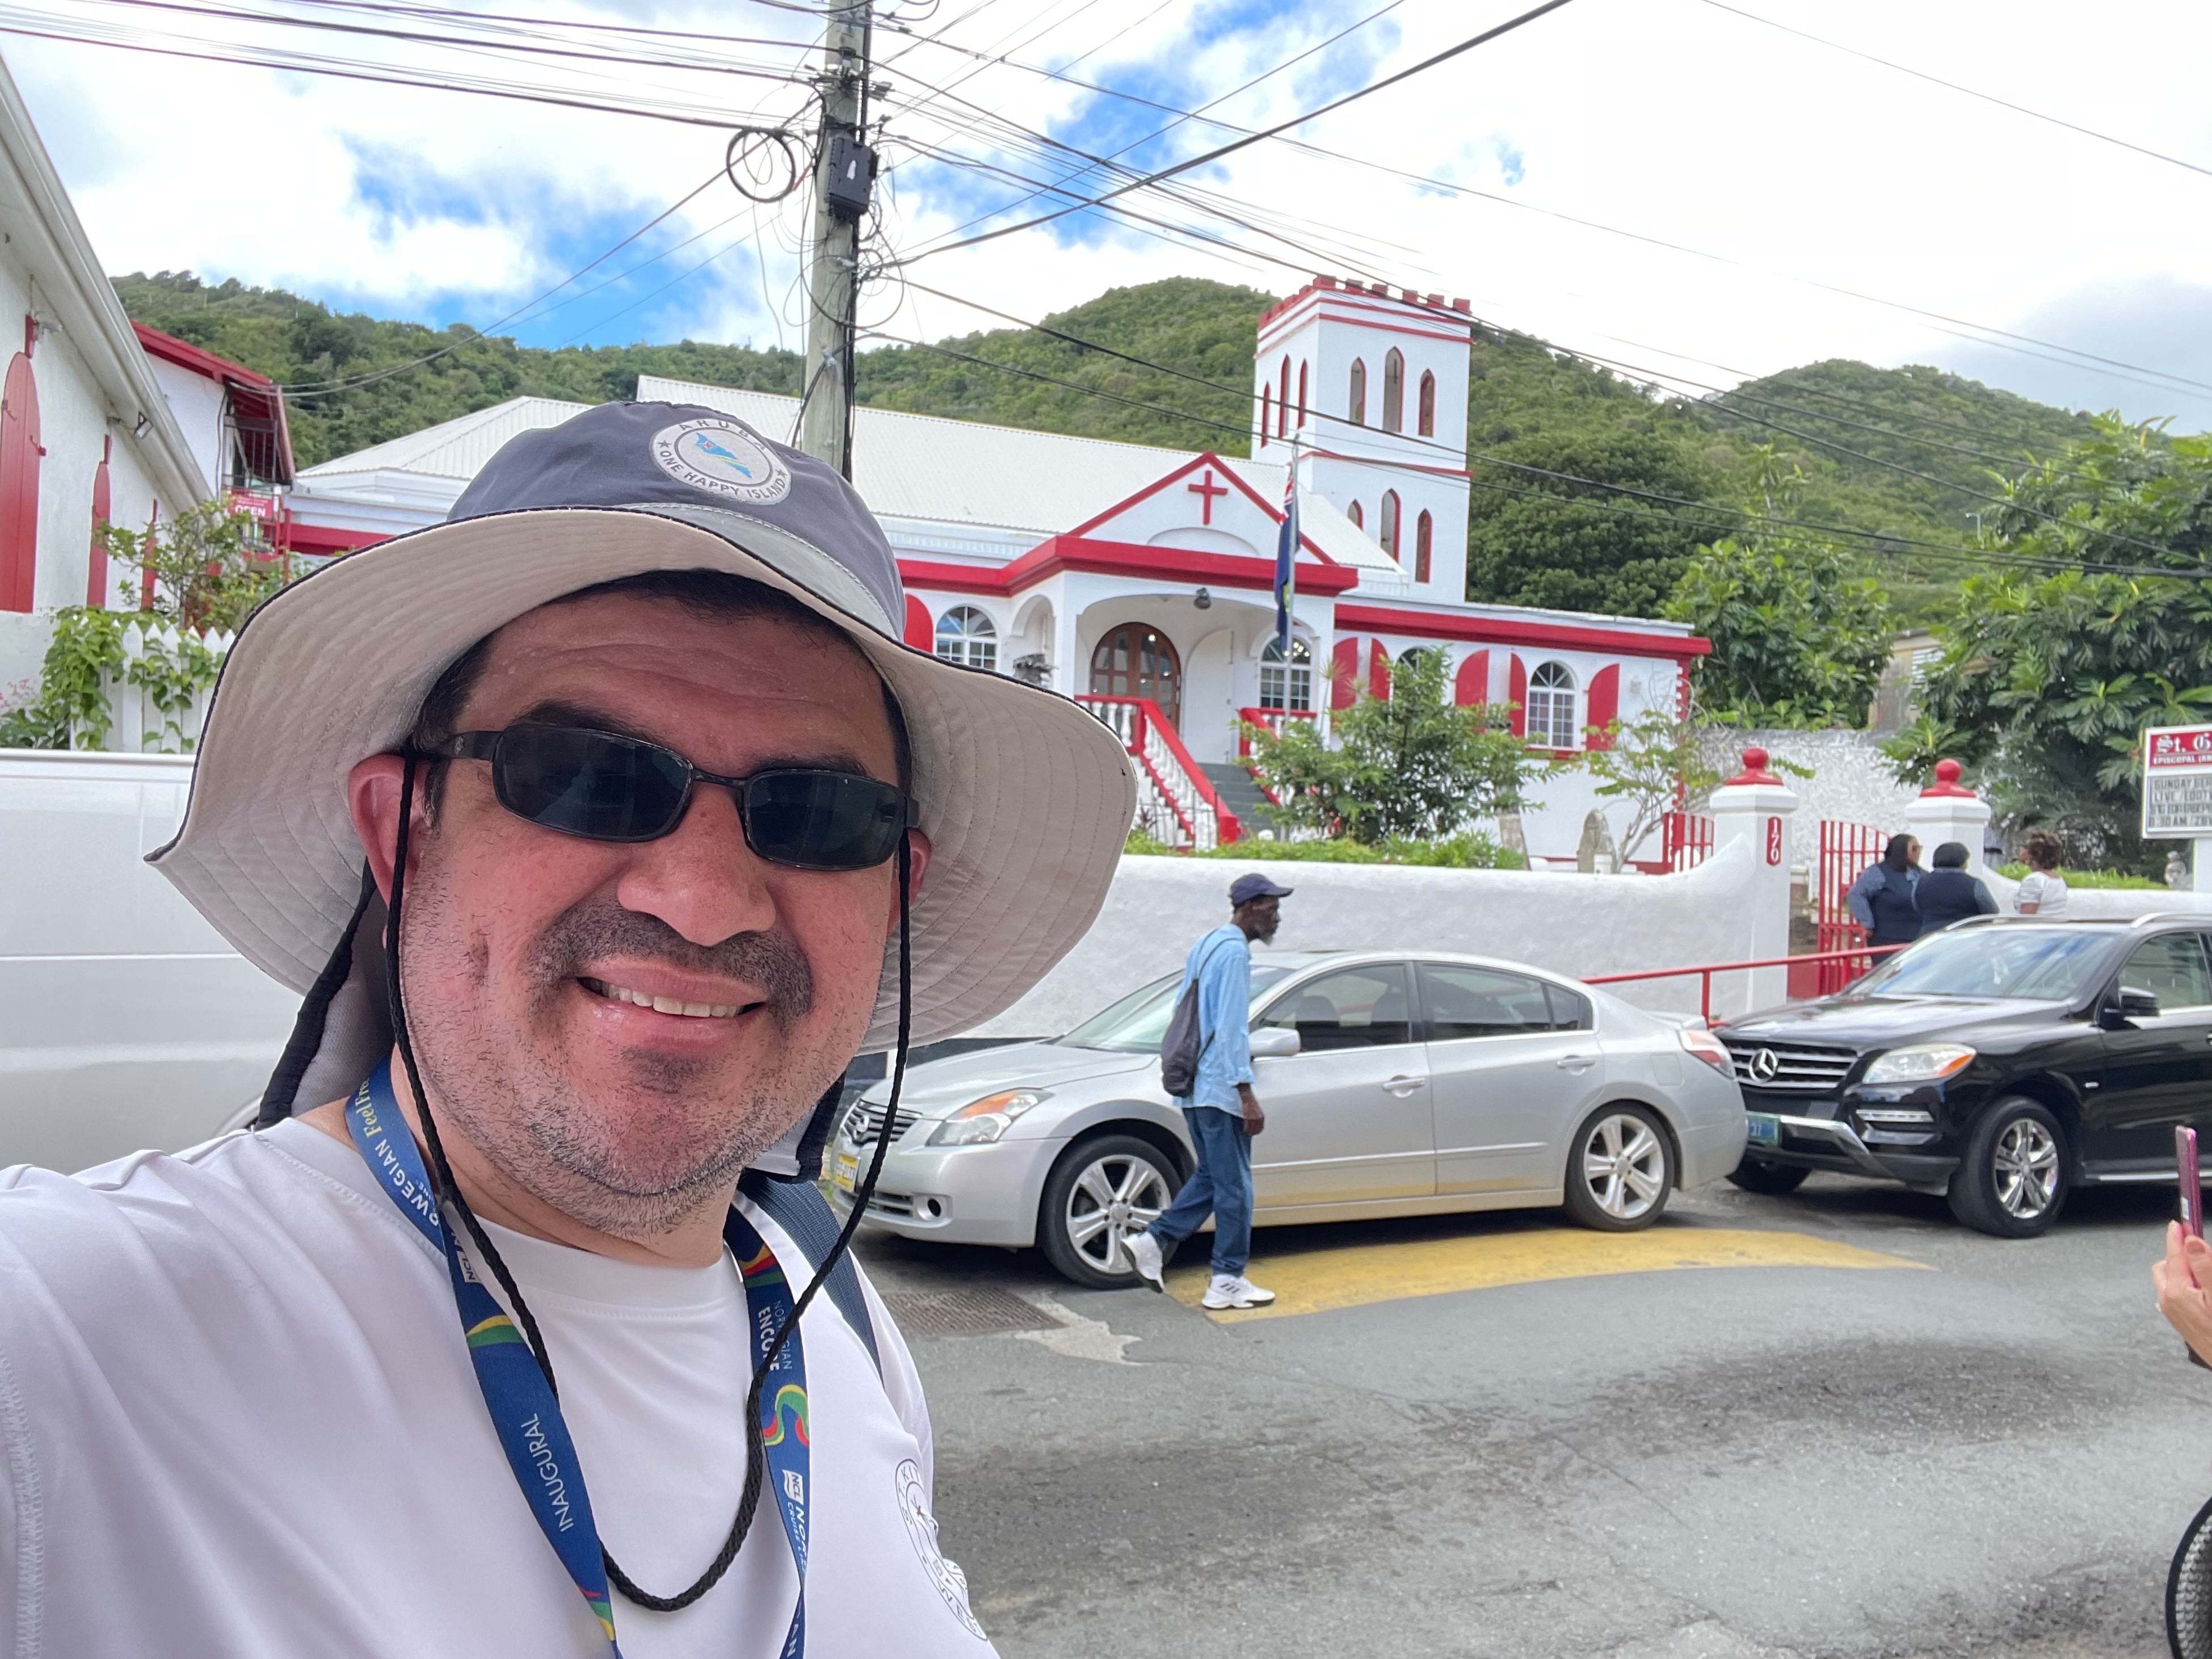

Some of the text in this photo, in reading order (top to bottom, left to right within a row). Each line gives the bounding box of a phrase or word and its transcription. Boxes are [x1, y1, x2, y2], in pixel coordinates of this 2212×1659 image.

[679, 419, 766, 451] ARUBA
[660, 450, 786, 499] ONE HAPPY ISLAND
[2157, 734, 2187, 753] St.
[2154, 778, 2192, 790] SUNDAY
[1770, 818, 1780, 862] 170
[355, 1103, 382, 1139] Feel
[461, 1256, 476, 1281] NCL
[758, 1306, 780, 1371] ENCOE
[520, 1413, 574, 1532] INAUGURAL
[792, 1474, 801, 1498] NCL
[787, 1502, 801, 1543] CRUISE
